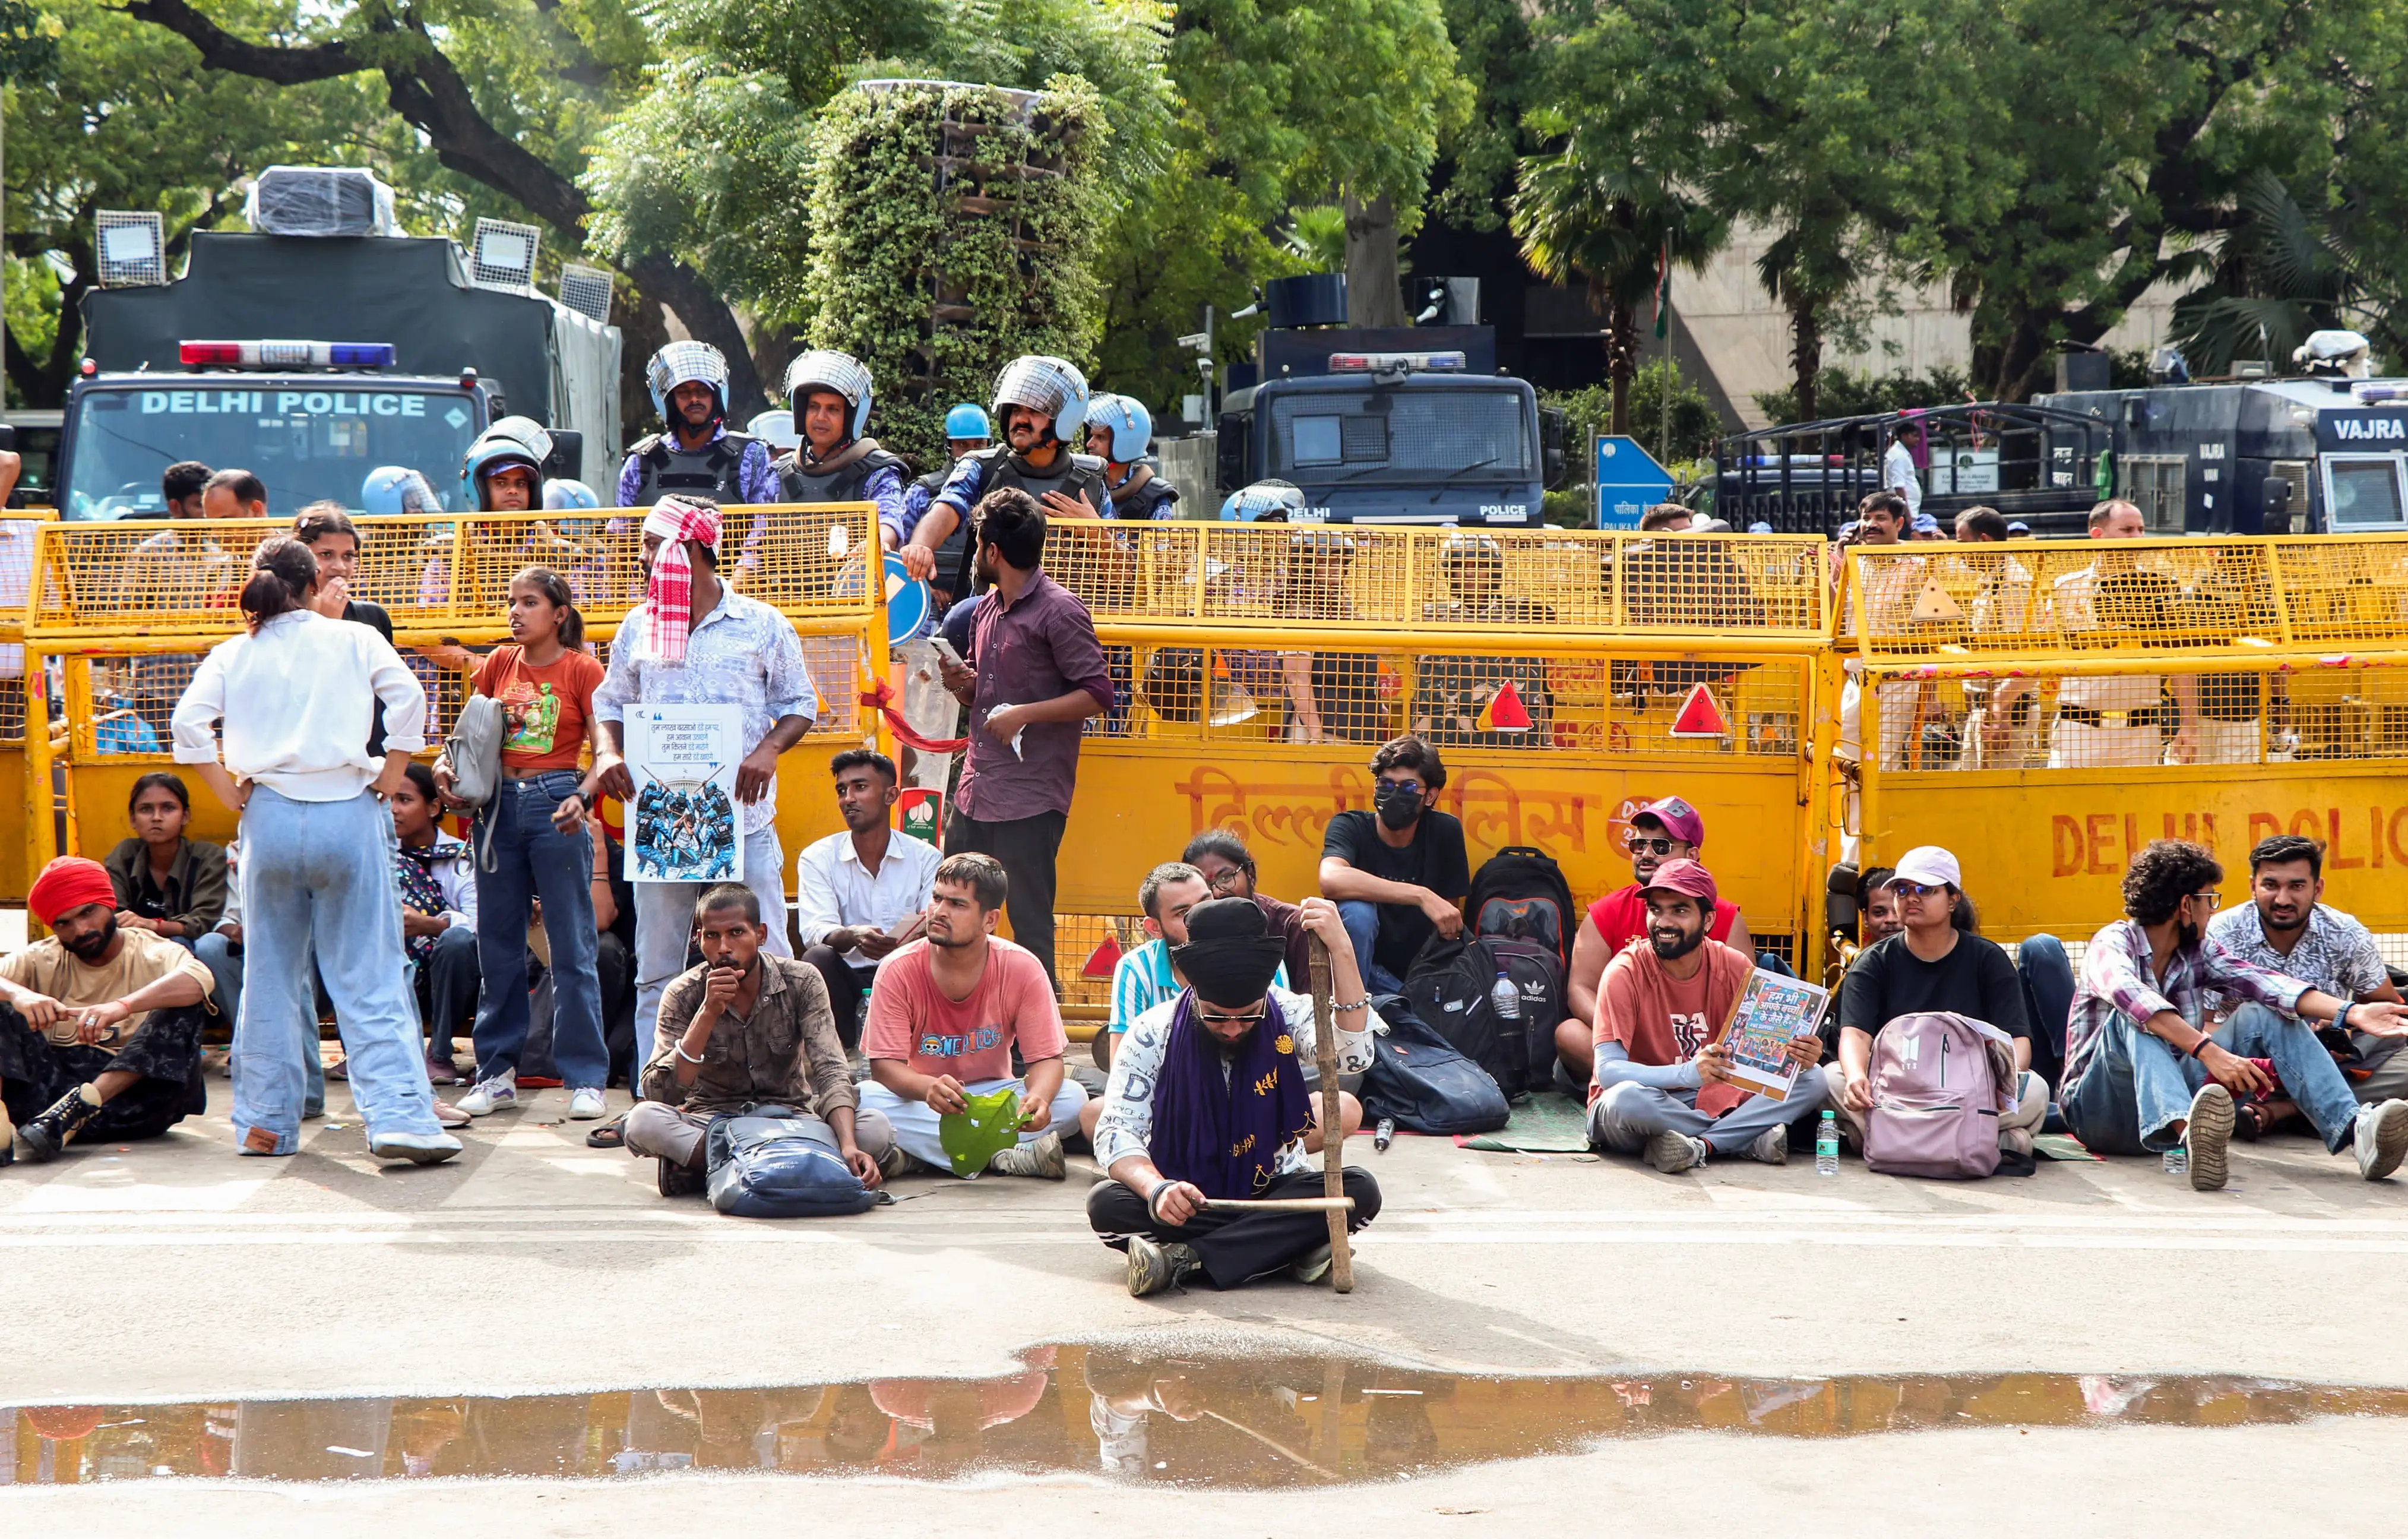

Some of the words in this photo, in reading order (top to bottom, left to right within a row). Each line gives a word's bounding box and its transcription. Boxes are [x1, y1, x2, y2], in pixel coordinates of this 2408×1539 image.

[142, 392, 262, 413] DELHI
[277, 393, 425, 416] POLICE
[2333, 419, 2406, 440] VAJRA
[2200, 444, 2225, 459] VAJRA
[2204, 469, 2219, 482] VAN
[1480, 505, 1527, 516] POLICE
[1613, 501, 1639, 515] पालिका
[1767, 991, 1783, 1003] हम
[1786, 991, 1799, 1005] भी
[1758, 1001, 1781, 1012] आपके
[1782, 1002, 1802, 1015] बच्चों
[1760, 1010, 1767, 1022] के
[1768, 1012, 1782, 1025] जैसे
